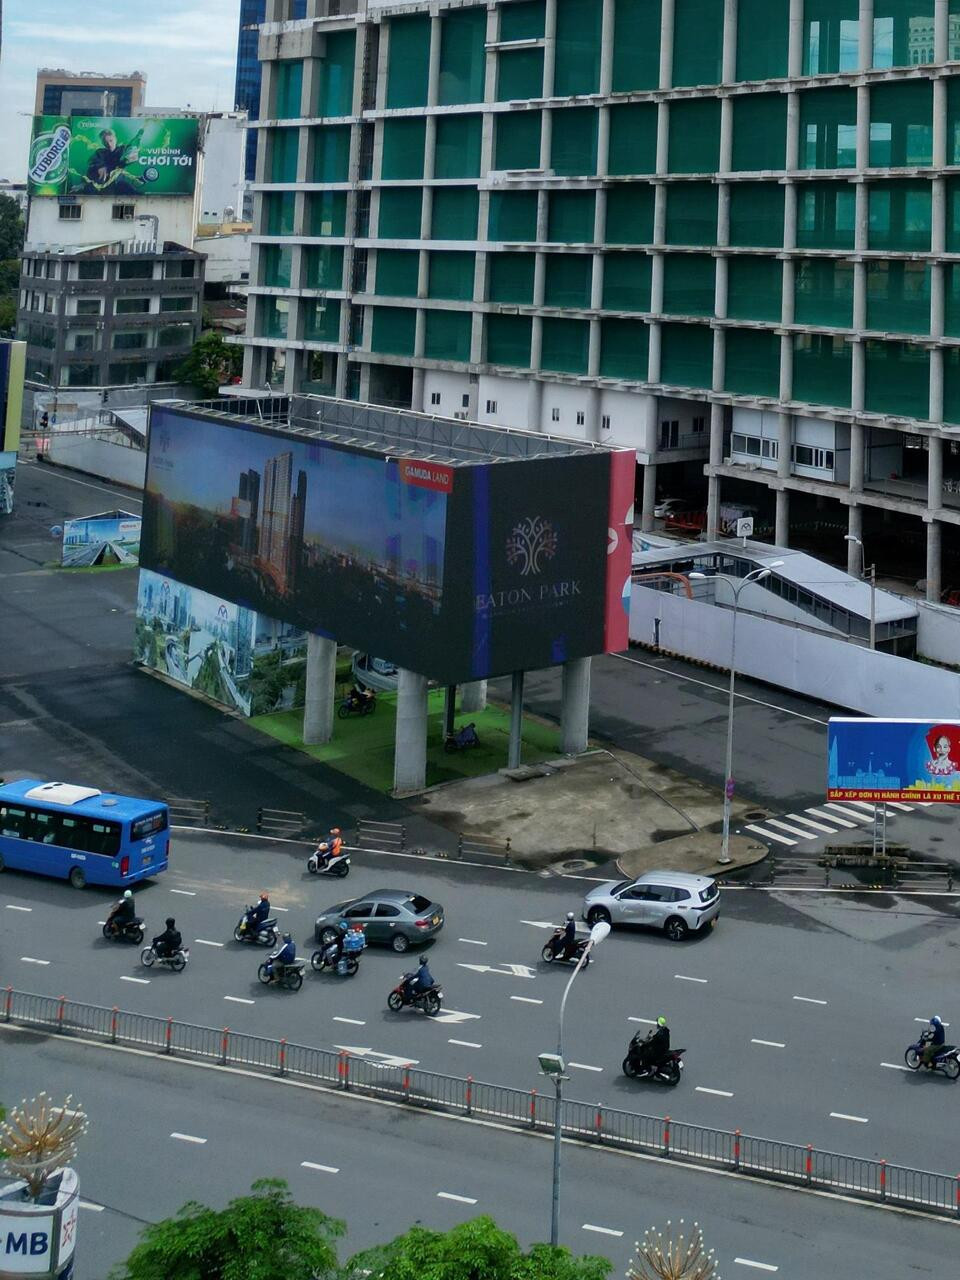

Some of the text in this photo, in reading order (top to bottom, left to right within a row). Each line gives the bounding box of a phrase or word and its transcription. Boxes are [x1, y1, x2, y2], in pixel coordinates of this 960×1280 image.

[31, 137, 67, 179] TUBORG
[138, 153, 192, 166] CHƠI TỚI
[476, 588, 532, 611] EATON
[540, 581, 581, 601] PARK
[5, 1231, 49, 1256] MB
